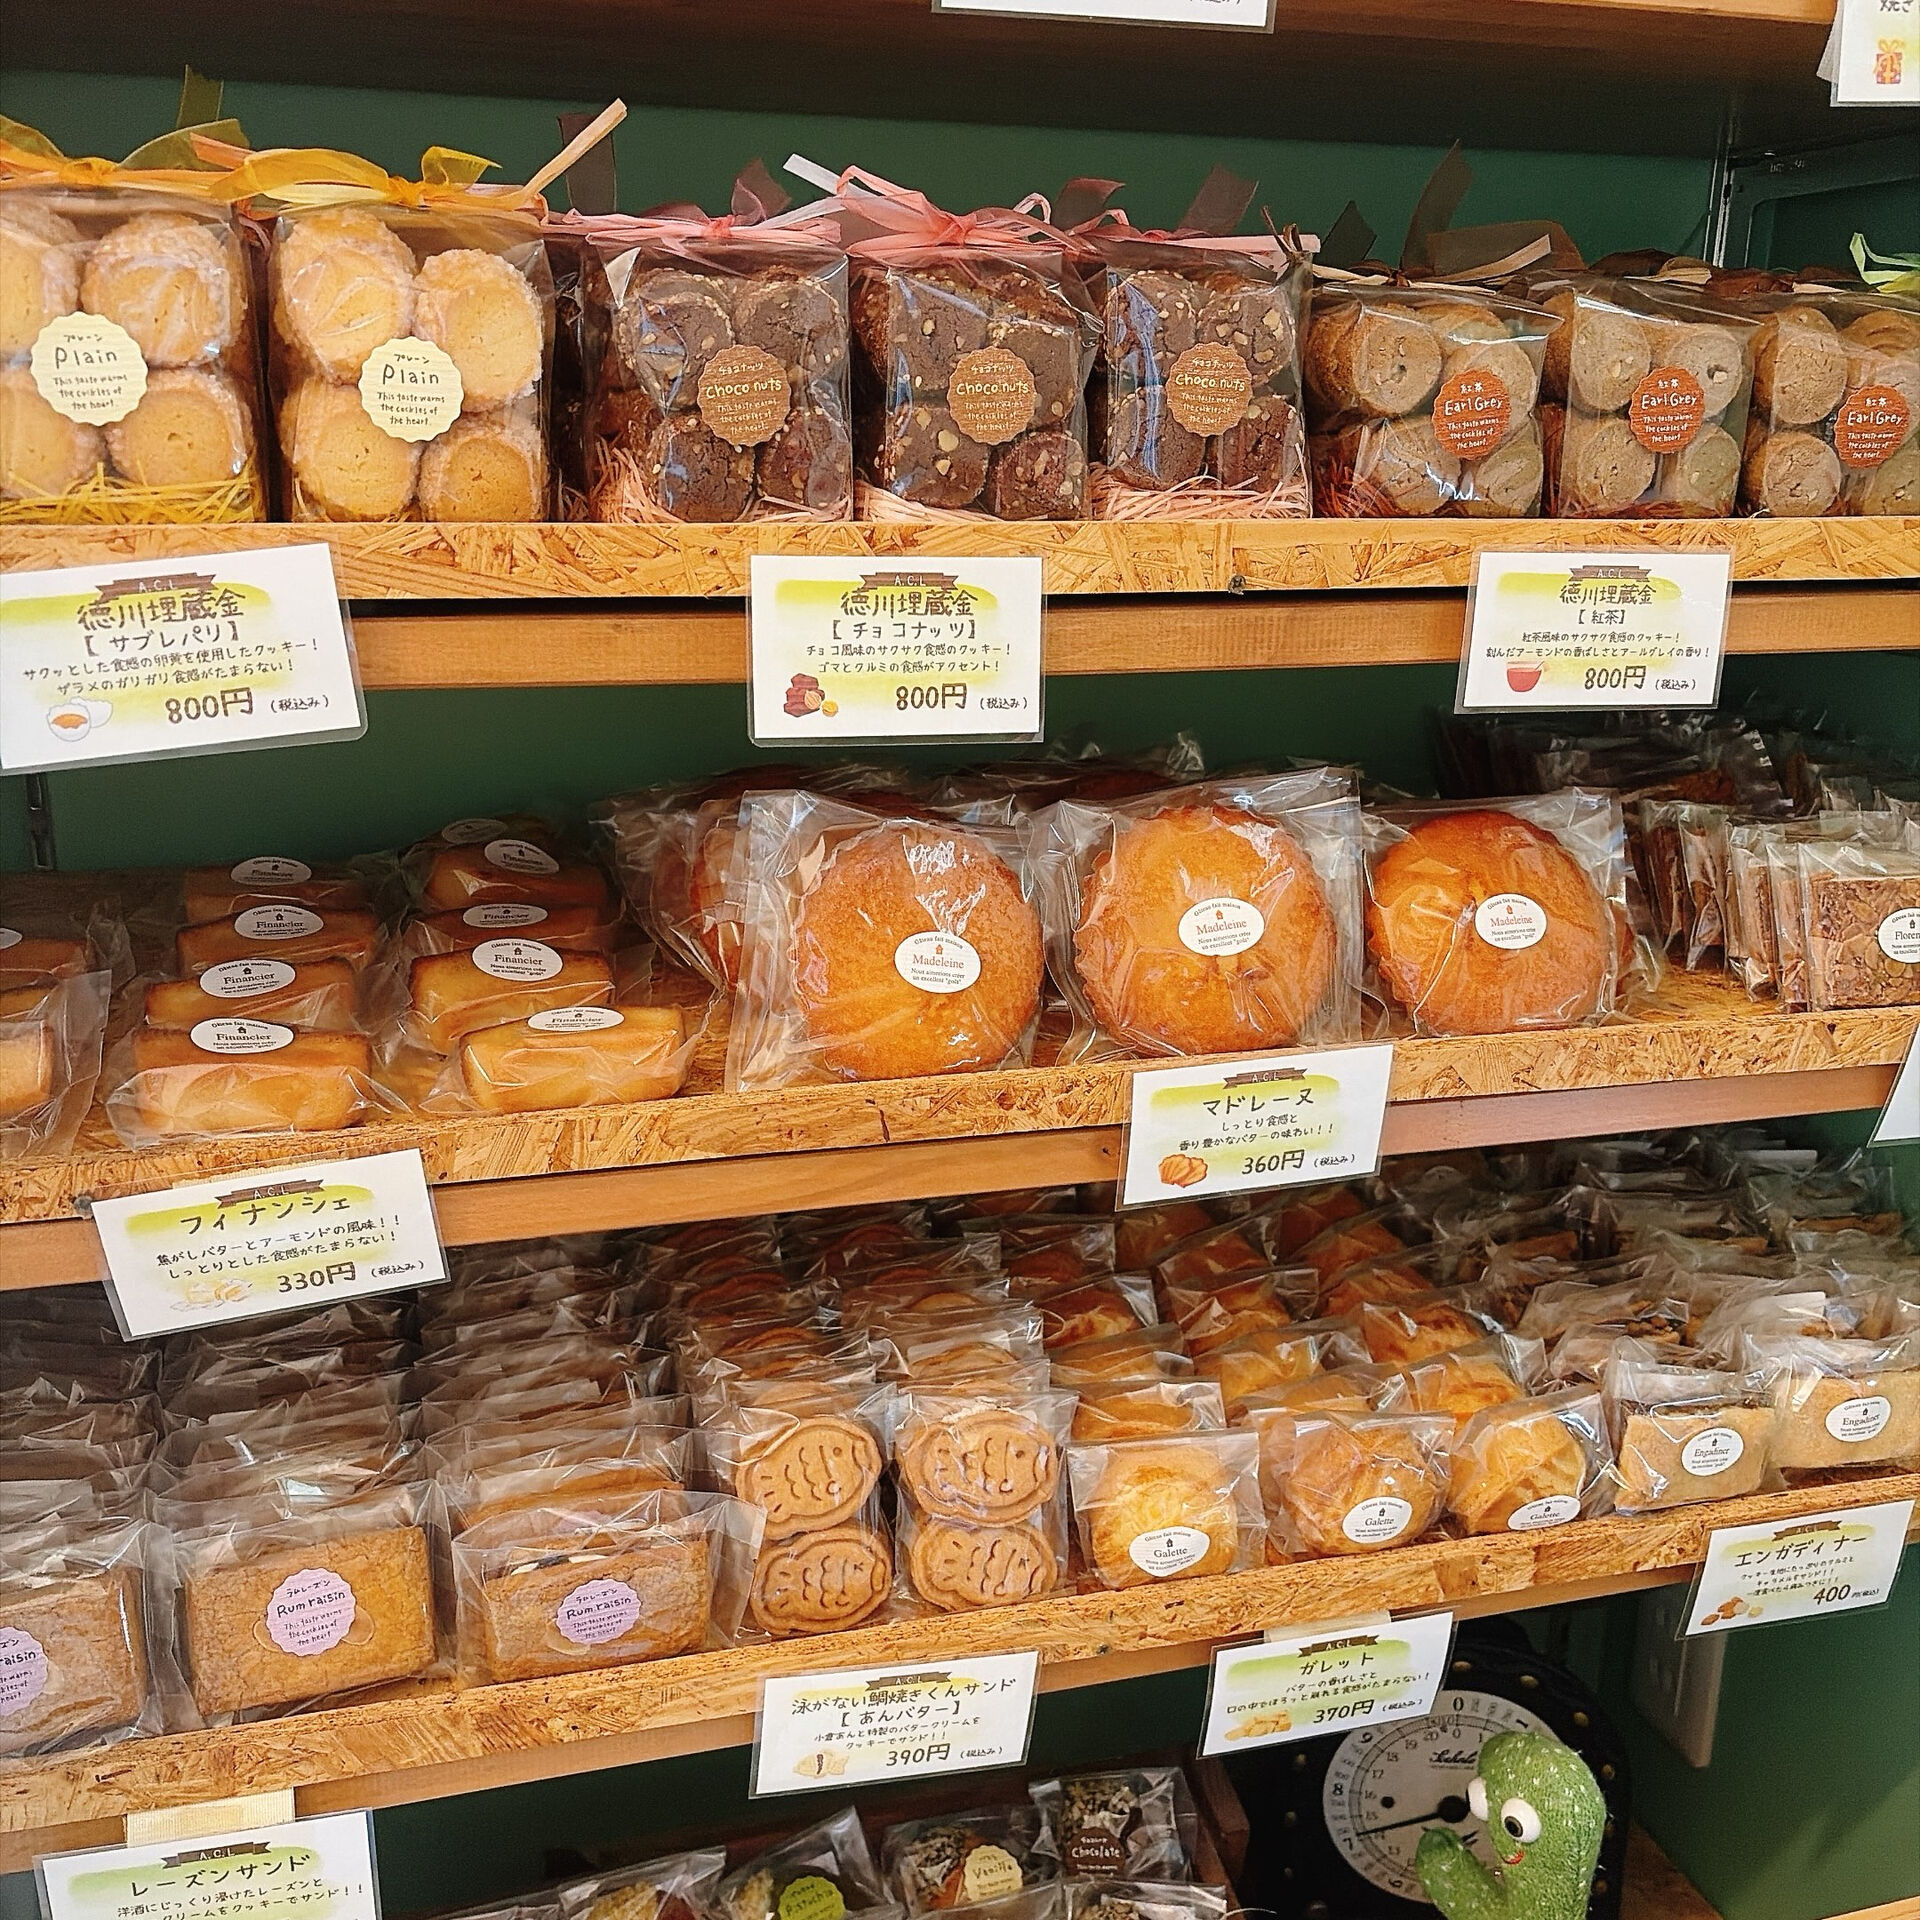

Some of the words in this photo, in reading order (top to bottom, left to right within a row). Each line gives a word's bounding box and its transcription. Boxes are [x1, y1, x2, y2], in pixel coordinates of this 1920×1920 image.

[55, 347, 117, 369] Plain
[394, 353, 430, 364] プレーン
[54, 377, 72, 385] This
[382, 363, 439, 385] Plain
[58, 389, 74, 398] the
[113, 385, 122, 394] of
[377, 391, 395, 401] This
[397, 393, 418, 402] taste
[1642, 393, 1668, 409] Earl
[1670, 392, 1697, 407] Grey
[72, 401, 87, 409] the
[380, 403, 394, 412] the
[396, 406, 427, 415] cockles
[429, 406, 438, 415] of
[1444, 398, 1472, 416] Earl
[1474, 396, 1502, 411] Grey
[390, 416, 403, 425] the
[1847, 411, 1873, 426] Earl
[1876, 411, 1903, 425] Grey
[840, 589, 978, 619] 徳川埋蔵金
[1560, 583, 1657, 606] 徳川埋蔵金
[78, 587, 247, 632] 徳川埋蔵金
[1577, 609, 1626, 625] 【紅茶】
[85, 620, 241, 657] 【サブレパリ】
[832, 620, 977, 640] 【チョコナッツ】
[1584, 665, 1647, 690] 800円
[165, 686, 254, 724] 800円
[895, 682, 968, 711] 800円
[1196, 920, 1247, 936] Madeleine
[1490, 915, 1533, 927] Madeleine
[494, 953, 543, 966] Financier
[912, 953, 965, 969] Madeleine
[223, 973, 275, 985] Financier
[216, 1033, 272, 1041] Financier
[1203, 1087, 1315, 1116] マドレーヌ
[1222, 1114, 1298, 1132] しっとり食感と
[1241, 1149, 1305, 1176] 360円
[181, 1196, 351, 1235] フィナンシェ
[277, 1260, 357, 1294] 330円
[1364, 1517, 1395, 1527] Galette
[1153, 1547, 1188, 1558] Galette
[1734, 1535, 1867, 1567] エンガディナー
[286, 1580, 331, 1598] ラムレーズン
[277, 1602, 306, 1618] Rum
[308, 1592, 346, 1607] raisin
[566, 1606, 593, 1620] Rum
[596, 1597, 631, 1611] raisin
[1300, 1652, 1375, 1677] ガレット
[791, 1677, 1017, 1716] 泳がない鯛焼きくんサンド
[1453, 1696, 1464, 1711] 0
[840, 1700, 961, 1728] 【あんバター】
[1313, 1699, 1376, 1724] 370円
[886, 1742, 950, 1768] 390円
[1072, 1845, 1120, 1858] Chocolate
[131, 1853, 311, 1898] レーズンサンド
[972, 1861, 1012, 1879] Vanilla
